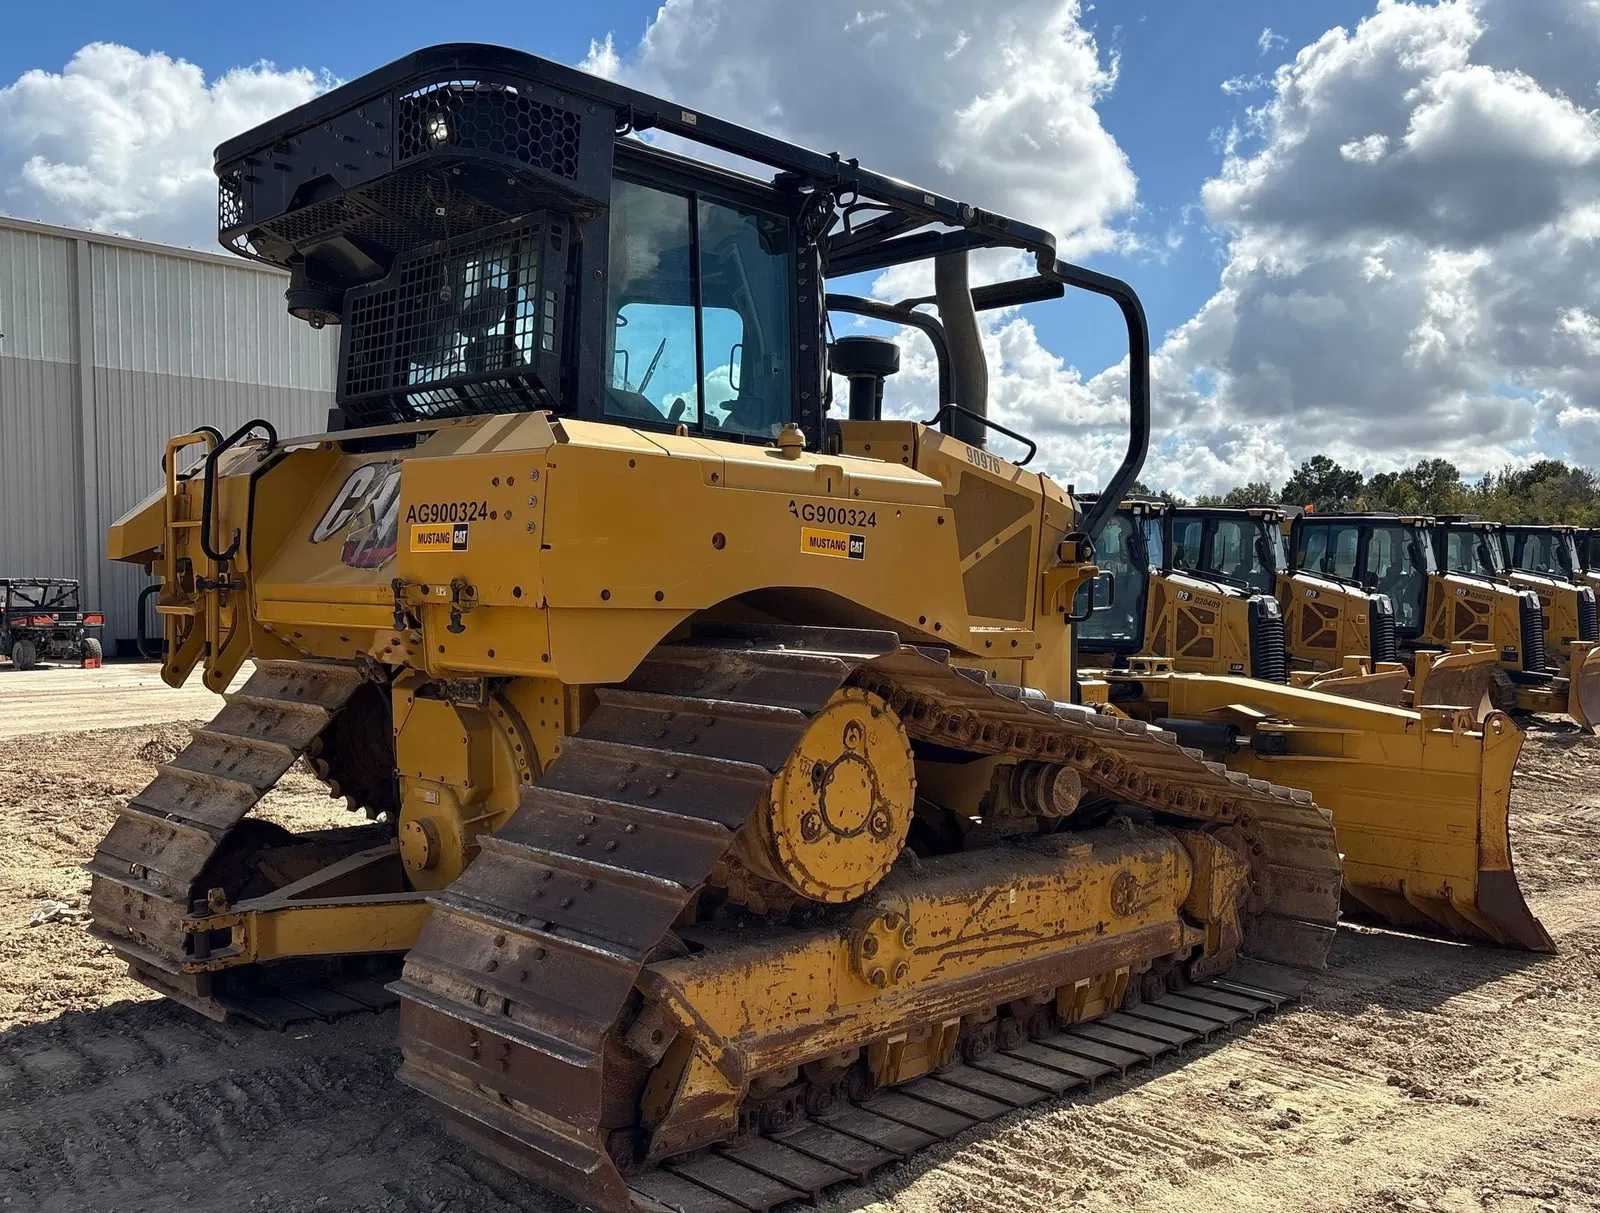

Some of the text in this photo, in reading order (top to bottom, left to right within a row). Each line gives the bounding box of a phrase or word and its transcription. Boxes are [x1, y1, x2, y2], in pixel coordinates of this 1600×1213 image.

[966, 446, 1000, 475] 90976
[406, 501, 487, 523] AG900324
[789, 500, 877, 527] AG900324
[418, 530, 467, 544] MUSTANG CAT
[809, 537, 863, 554] MUSTANG CAT
[1177, 590, 1220, 609] D3 020409
